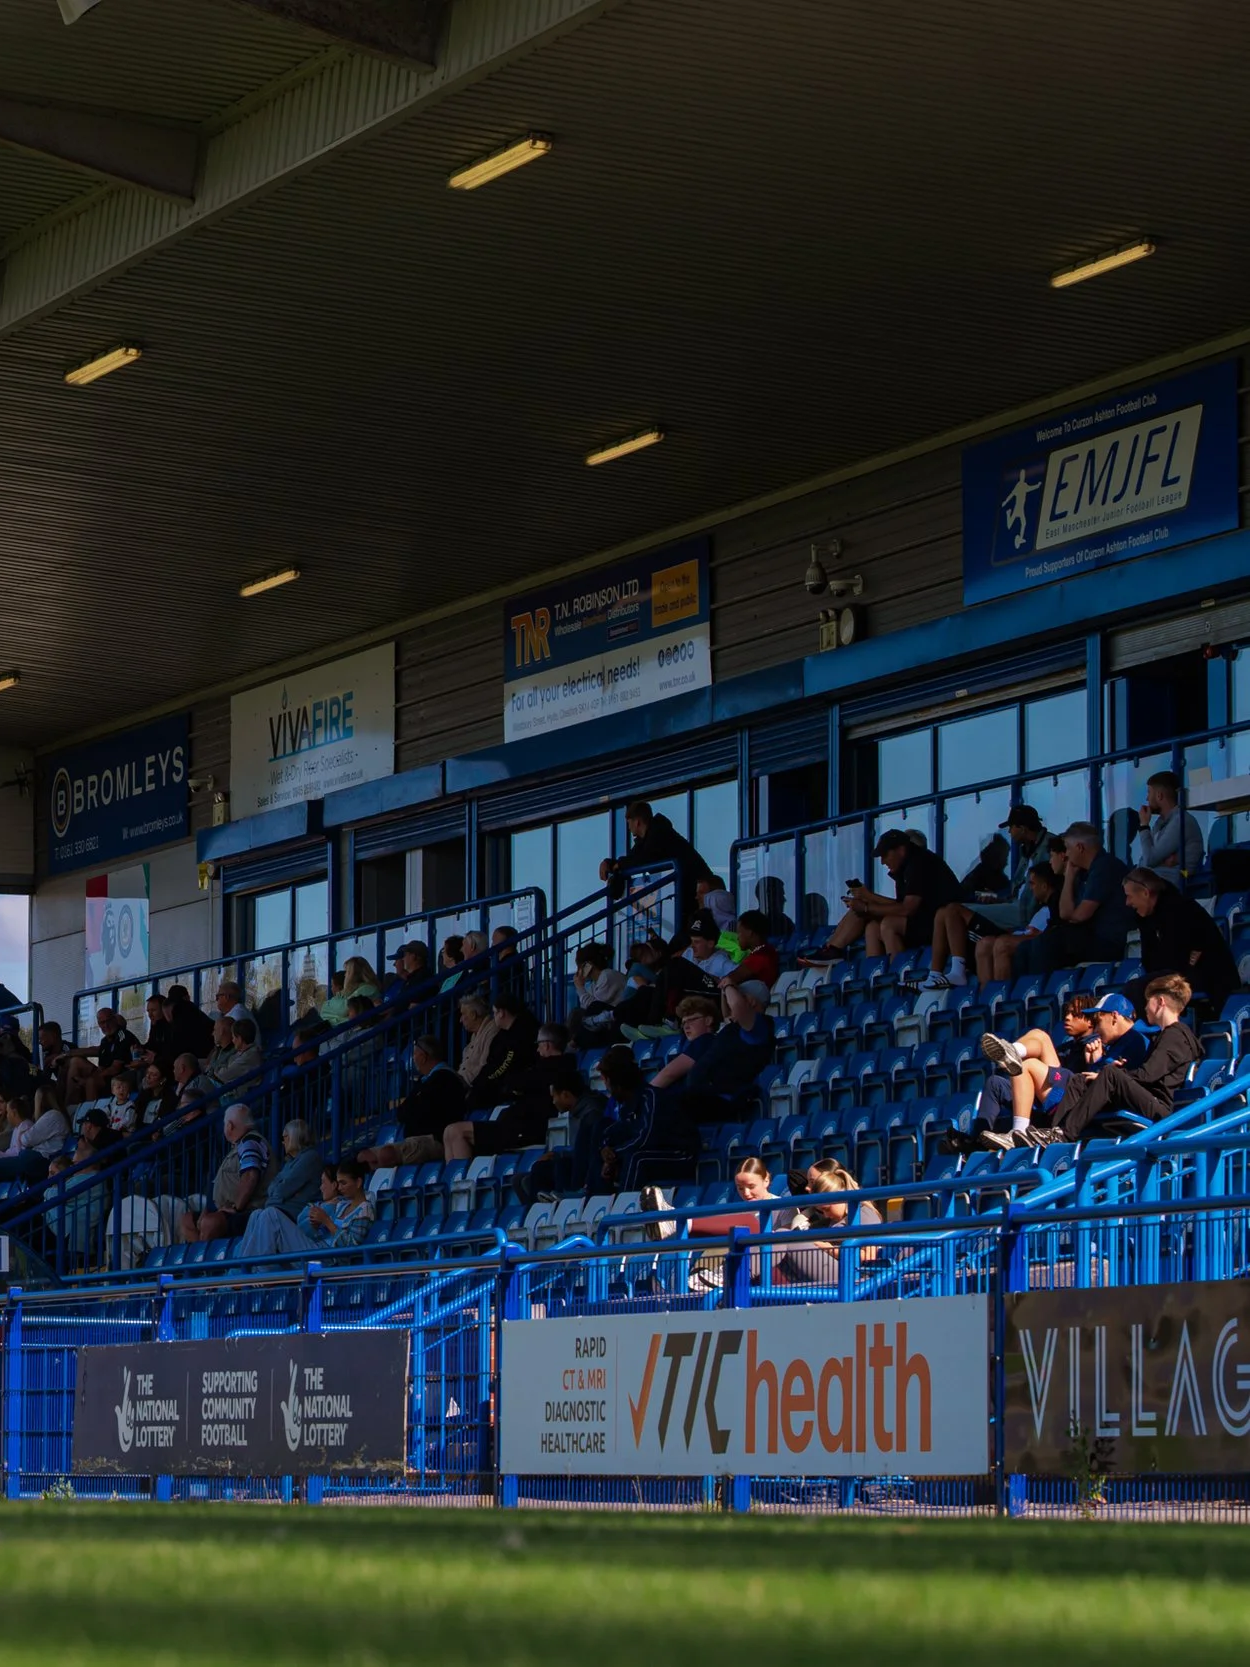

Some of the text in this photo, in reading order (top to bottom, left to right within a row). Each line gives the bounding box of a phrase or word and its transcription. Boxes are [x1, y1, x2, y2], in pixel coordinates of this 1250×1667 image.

[1036, 392, 1157, 442] Welcome To Curzon Ashton Football Club
[1049, 420, 1181, 522] EMJFL
[1157, 490, 1182, 505] League
[1025, 526, 1169, 578] Proud Supporters Of Curzon Ashton Football Club
[573, 584, 620, 614] ROBINSON
[622, 578, 640, 600] LTD
[511, 607, 551, 670] TNR
[512, 692, 524, 712] For
[527, 685, 538, 708] all
[540, 684, 560, 710] your
[562, 665, 605, 698] electrical
[607, 656, 640, 685] needs!
[73, 745, 184, 815] BROMLEYS
[270, 769, 284, 785] Wet
[57, 790, 66, 816] B
[575, 1336, 607, 1358] RAPID
[136, 1374, 154, 1396] THE
[202, 1370, 258, 1394] SUPPORTING
[303, 1367, 324, 1391] THE
[562, 1368, 607, 1391] CT & MRI
[136, 1400, 180, 1422] NATIONAL
[202, 1397, 257, 1420] COMMUNITY
[303, 1394, 353, 1419] NATIONAL
[545, 1400, 607, 1423] DIAGNOSTIC
[135, 1426, 175, 1448] LOTTERY
[201, 1424, 248, 1447] FOOTBALL
[303, 1423, 348, 1447] LOTTERY
[540, 1431, 607, 1454] HEALTHCARE
